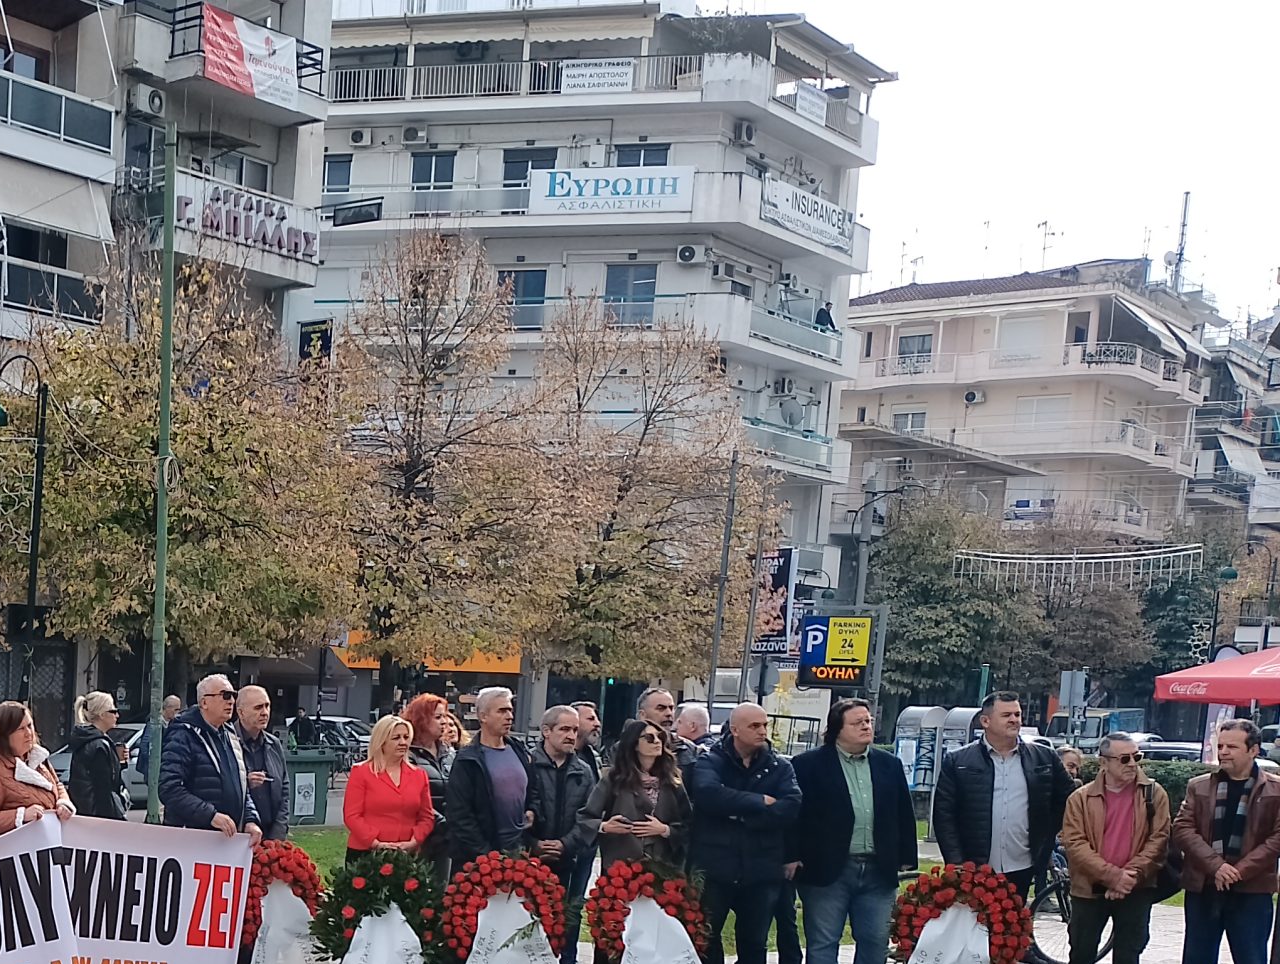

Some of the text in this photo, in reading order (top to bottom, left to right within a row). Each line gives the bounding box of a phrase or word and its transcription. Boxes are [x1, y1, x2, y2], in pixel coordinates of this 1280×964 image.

[557, 200, 662, 211] ΑΣΦΑΛΙΣΤΙΚΗ
[791, 190, 842, 230] INSURANCE
[202, 203, 318, 256] ΜΠΙΛΛΗΣ
[841, 638, 854, 649] 24
